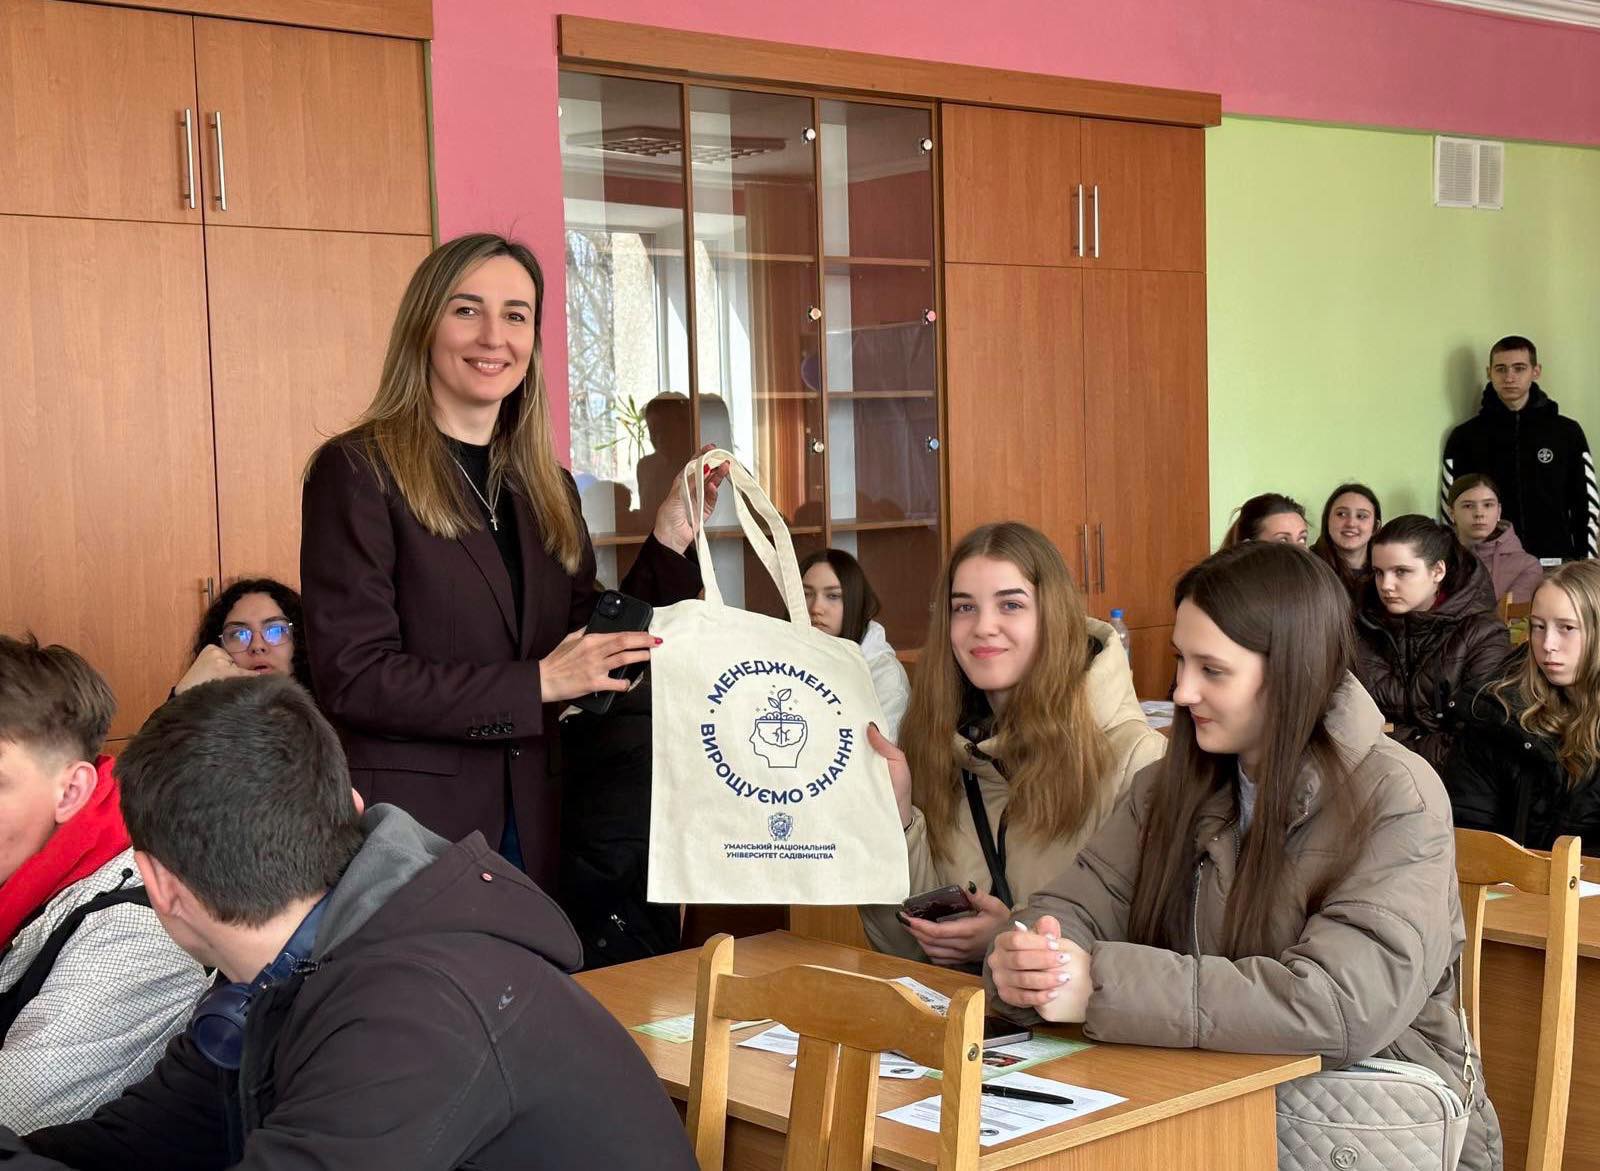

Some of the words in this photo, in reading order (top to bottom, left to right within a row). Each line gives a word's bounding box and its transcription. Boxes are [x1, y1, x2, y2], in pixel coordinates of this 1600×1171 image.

[707, 660, 841, 707] МЕНЕДЖМЕНТ
[701, 724, 804, 805] ВИРОЩУЄМО
[806, 728, 854, 798] ЗНАННЯ
[723, 843, 772, 851] УМАНСЬКИЙ
[774, 843, 836, 852] НАЦІОНАЛЬНИЙ
[780, 852, 834, 860] САДІВНИЦТВА
